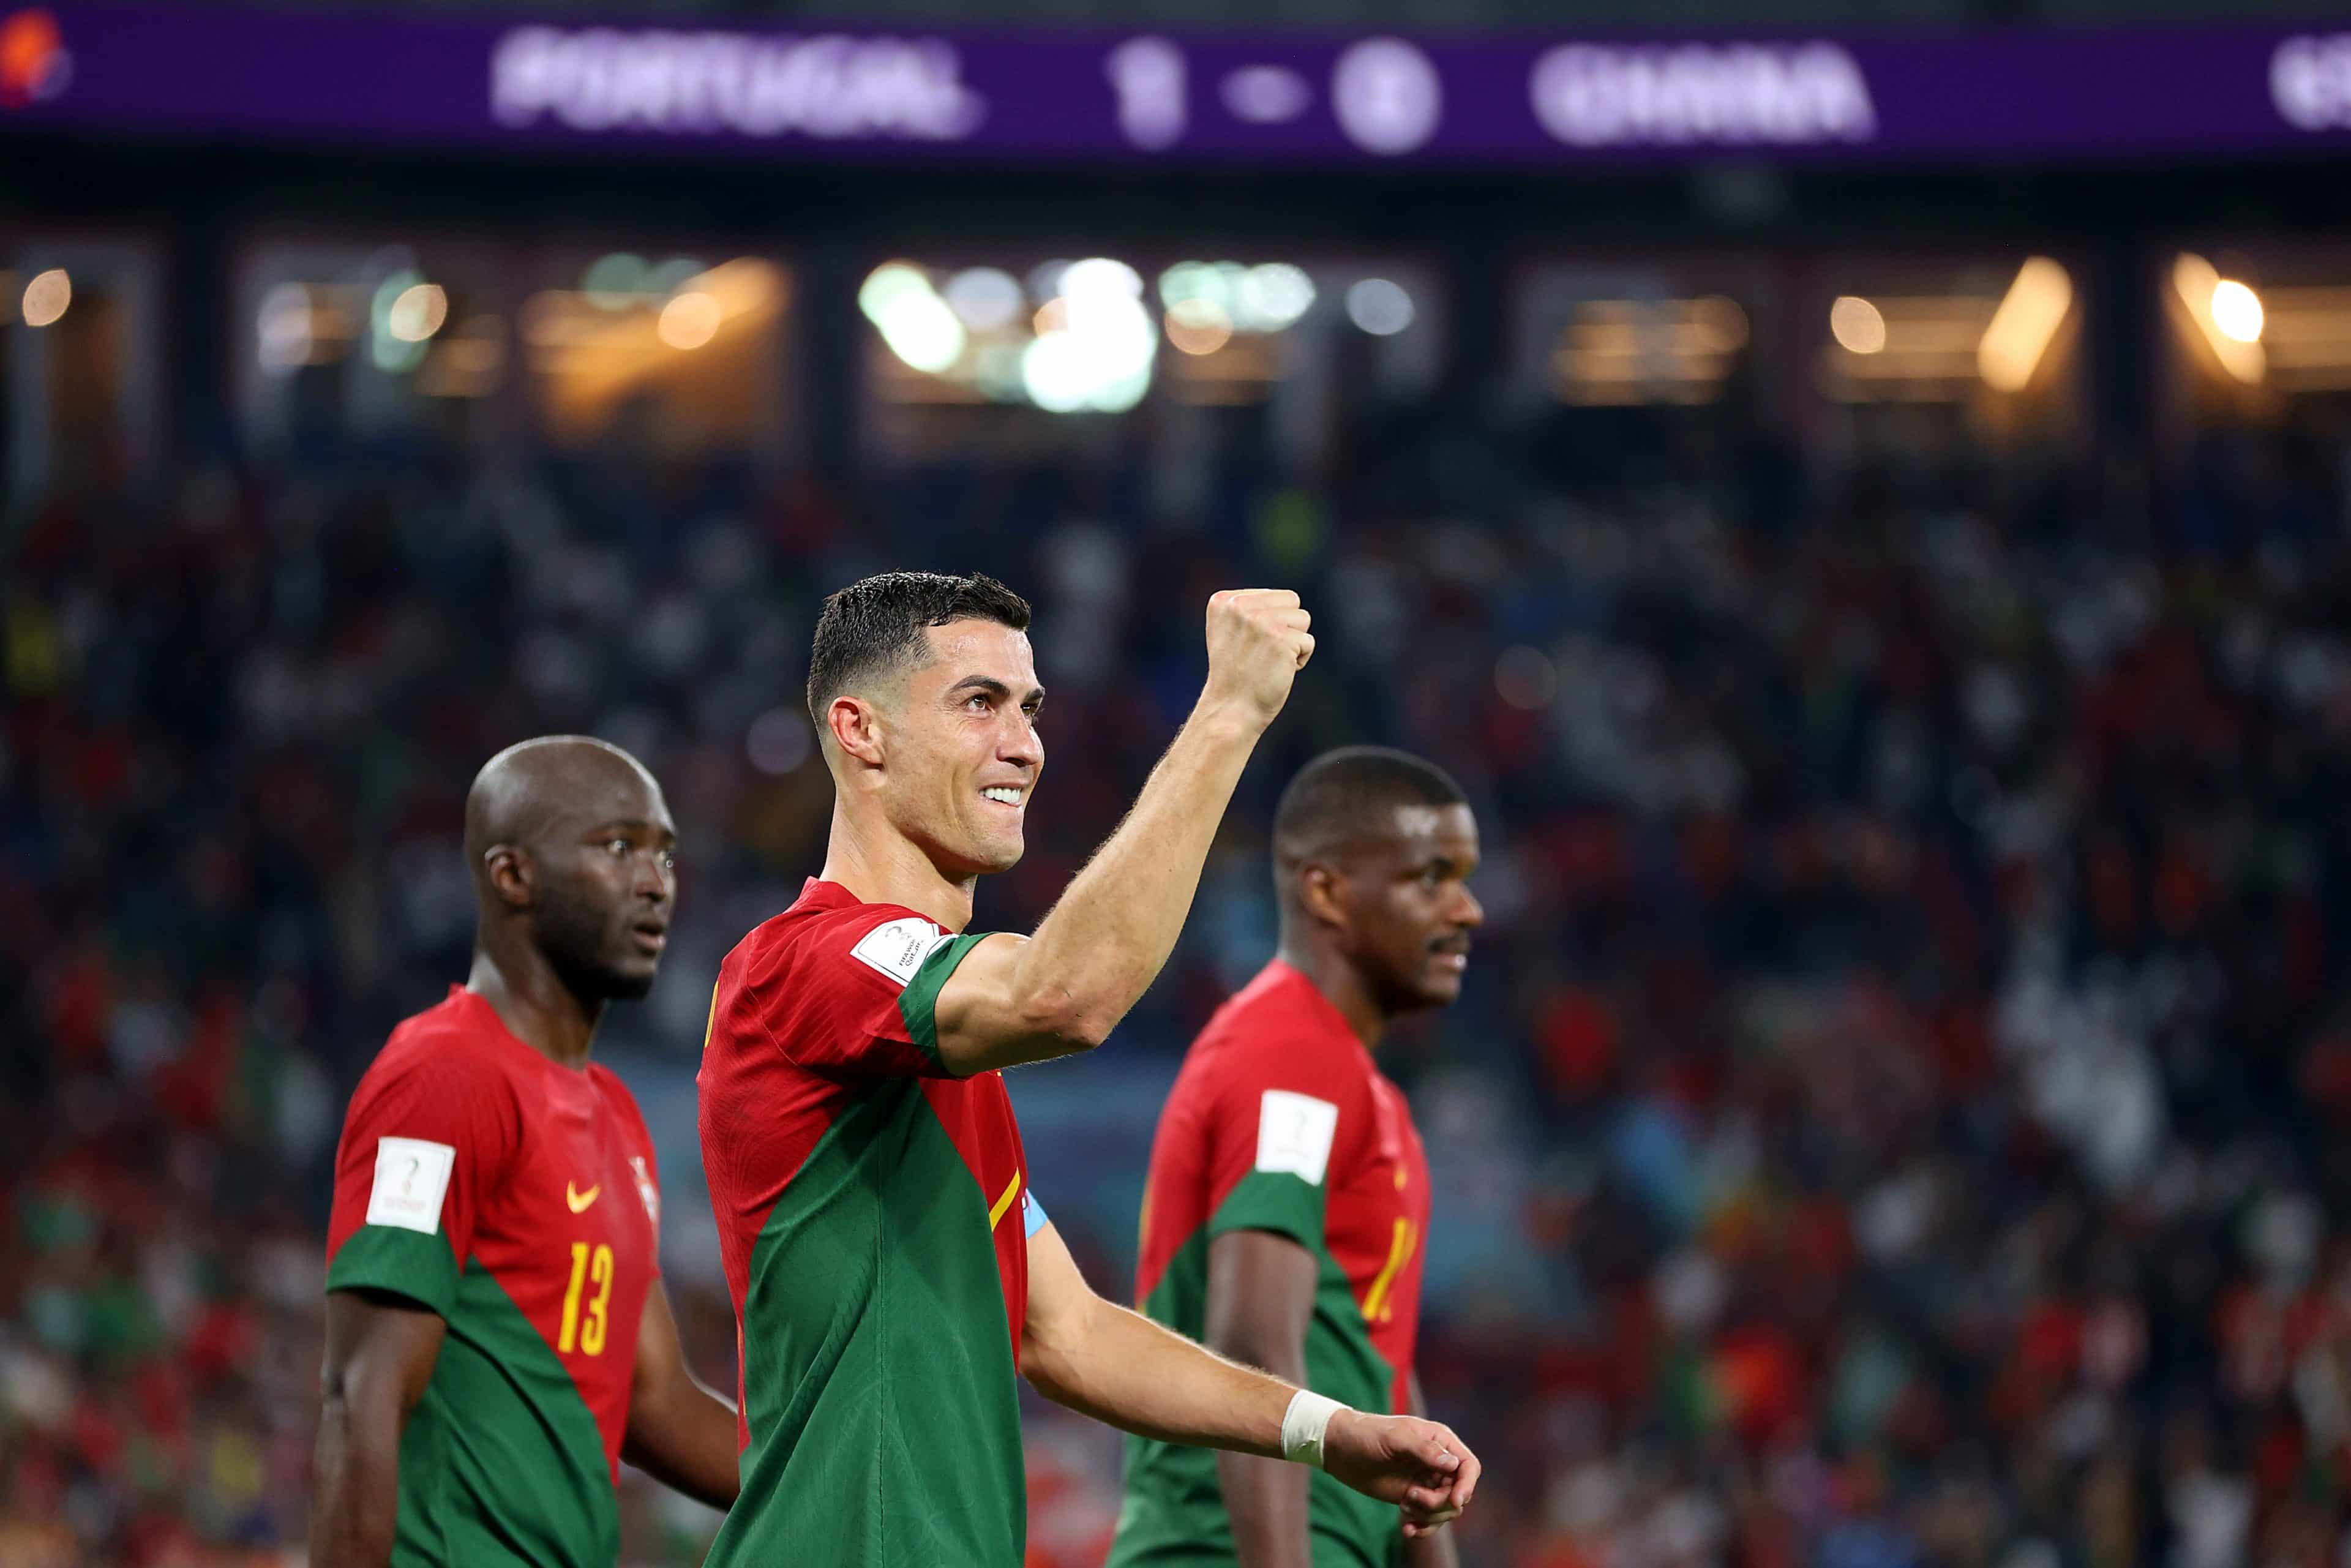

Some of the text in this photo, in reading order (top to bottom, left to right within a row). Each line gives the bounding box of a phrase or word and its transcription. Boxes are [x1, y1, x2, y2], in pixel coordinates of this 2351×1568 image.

[491, 27, 981, 140] PORTUGAL
[1109, 37, 1186, 149] 1
[1529, 43, 1875, 145] GHANA
[558, 1242, 613, 1356] 13
